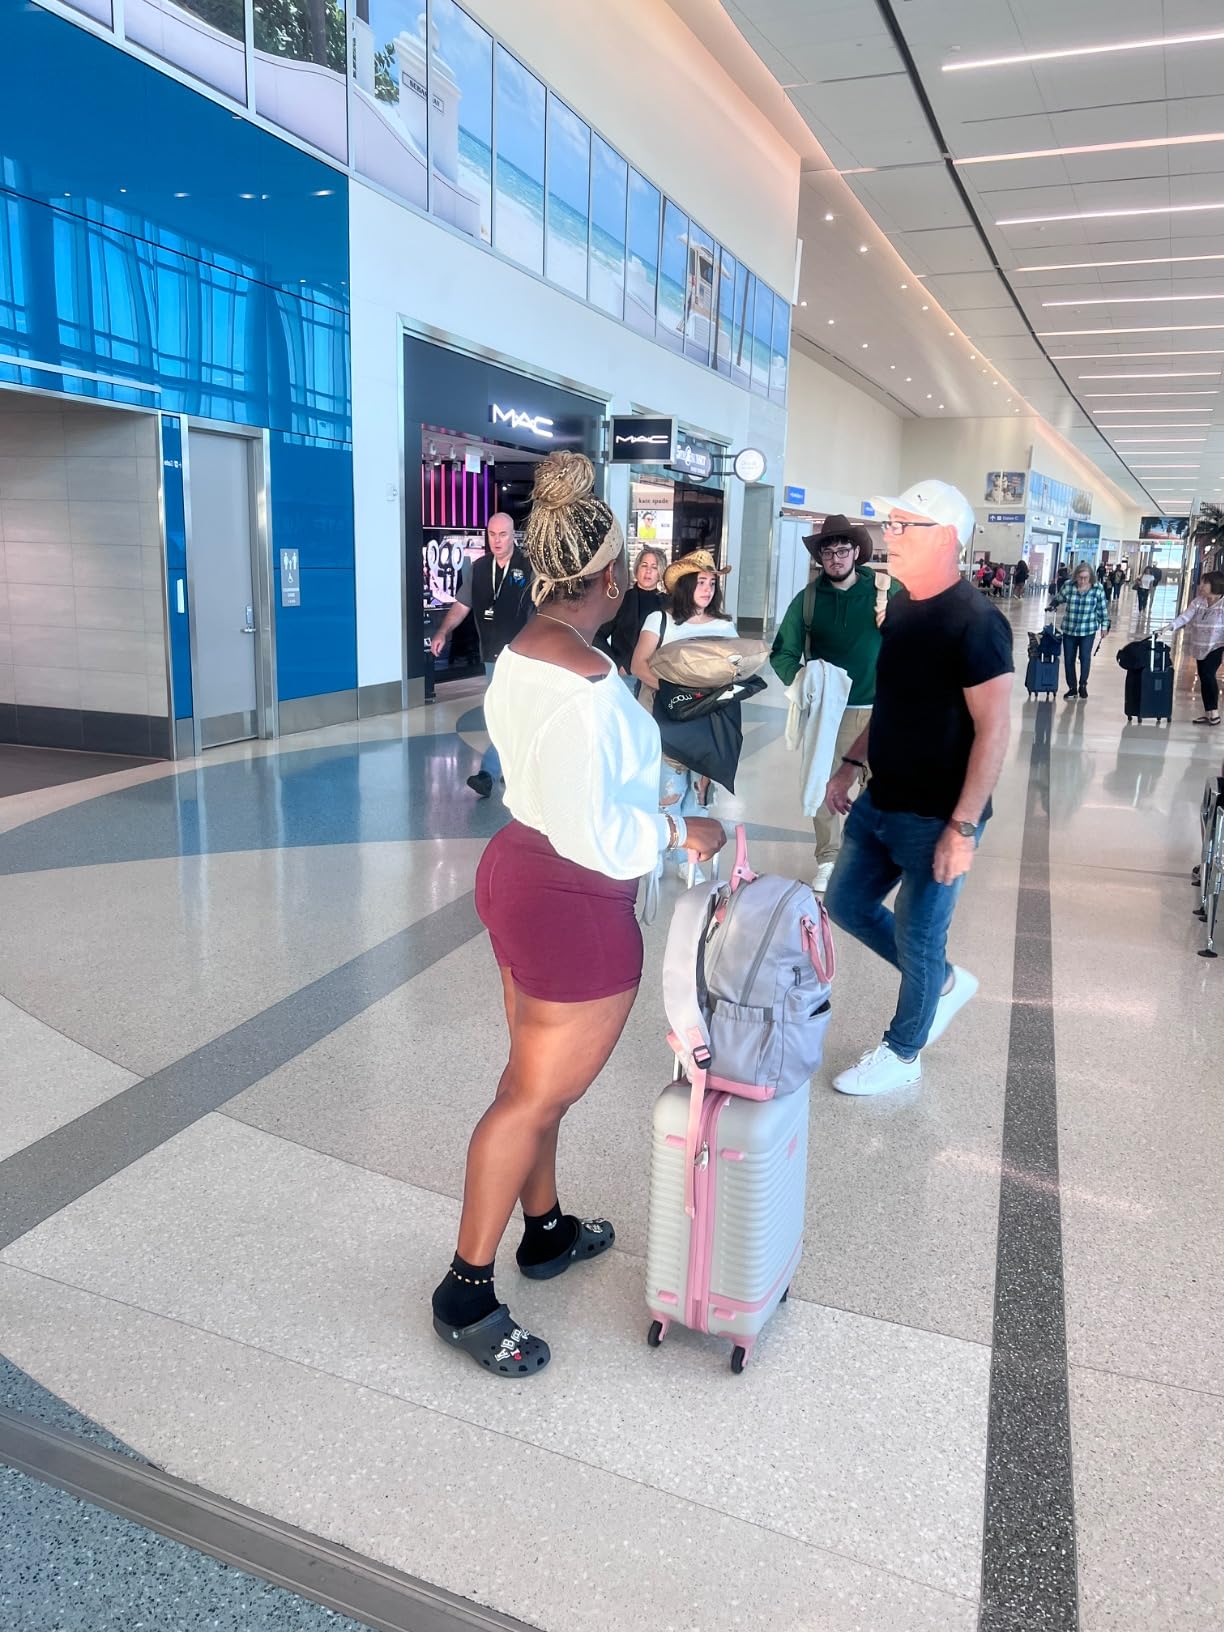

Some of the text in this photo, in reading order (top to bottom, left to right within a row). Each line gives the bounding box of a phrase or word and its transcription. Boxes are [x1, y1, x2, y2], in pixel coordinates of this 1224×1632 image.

[491, 402, 554, 438] MAC
[615, 434, 669, 444] MAC
[652, 497, 669, 505] spade
[668, 693, 693, 710] macy's
